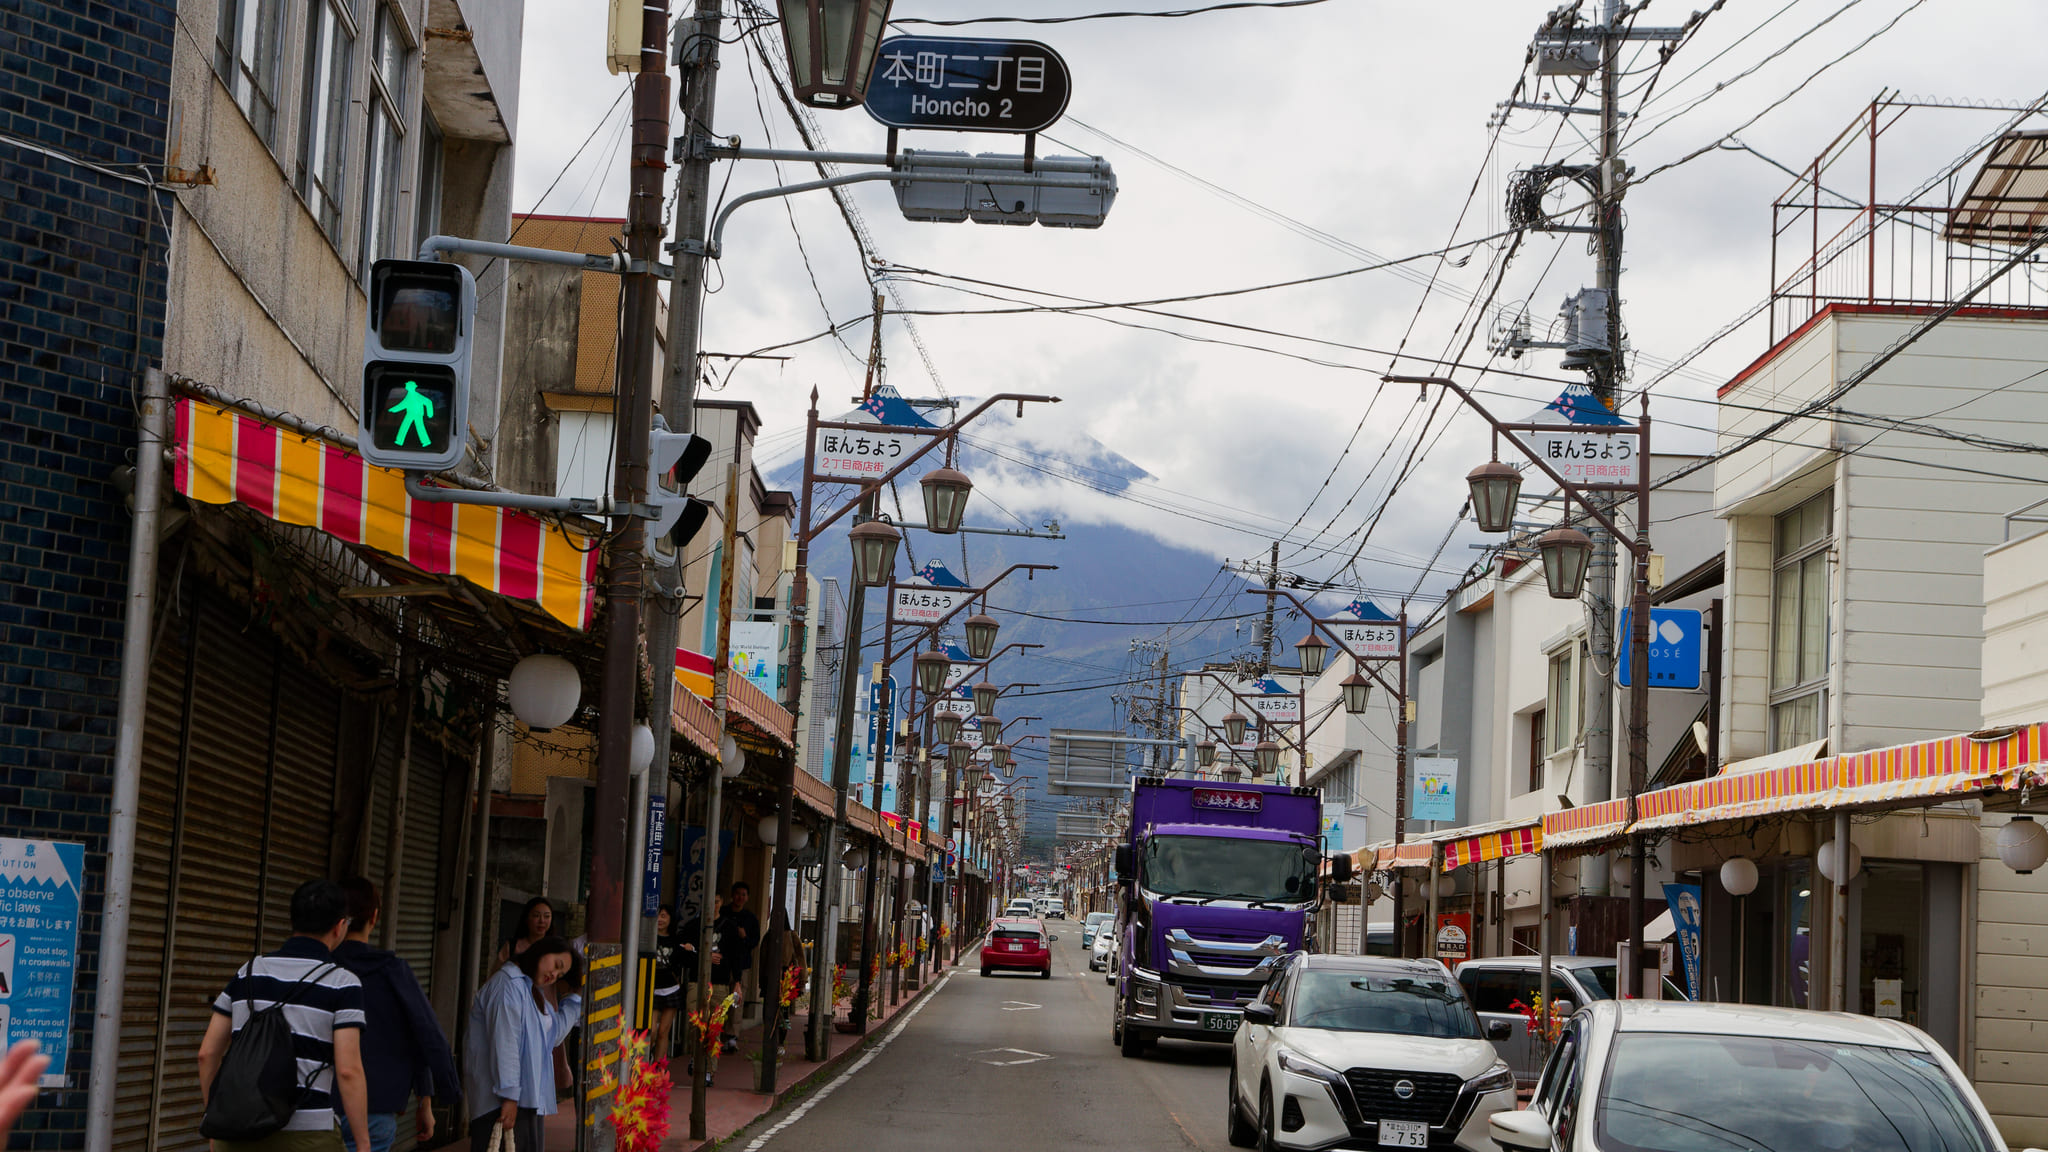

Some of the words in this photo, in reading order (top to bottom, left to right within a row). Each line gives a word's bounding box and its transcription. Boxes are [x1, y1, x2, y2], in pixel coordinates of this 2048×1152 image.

[881, 49, 1046, 94] 本町二丁目
[911, 94, 990, 118] Honcho
[999, 98, 1013, 119] 2
[824, 435, 902, 458] ほんちょう
[1547, 439, 1632, 460] ほんちょう
[822, 457, 884, 473] 2丁目商店街
[1564, 463, 1631, 477] 2丁目商店街
[899, 593, 952, 609] ほんちょう
[1344, 629, 1395, 641] ほんちょう
[1650, 647, 1681, 659] OSÉ
[1257, 700, 1297, 710] ほんちょう
[1, 859, 37, 869] UTION
[652, 876, 657, 889] 1
[8, 887, 54, 900] observe
[15, 901, 41, 914] laws
[24, 946, 36, 954] Do
[37, 947, 50, 955] not
[52, 948, 68, 957] stop
[28, 959, 71, 967] crosswalks
[10, 1017, 21, 1026] Do
[23, 1018, 36, 1026] not
[52, 1019, 65, 1027] out
[11, 1030, 29, 1038] onto
[31, 1029, 43, 1038] the
[45, 1030, 63, 1038] road
